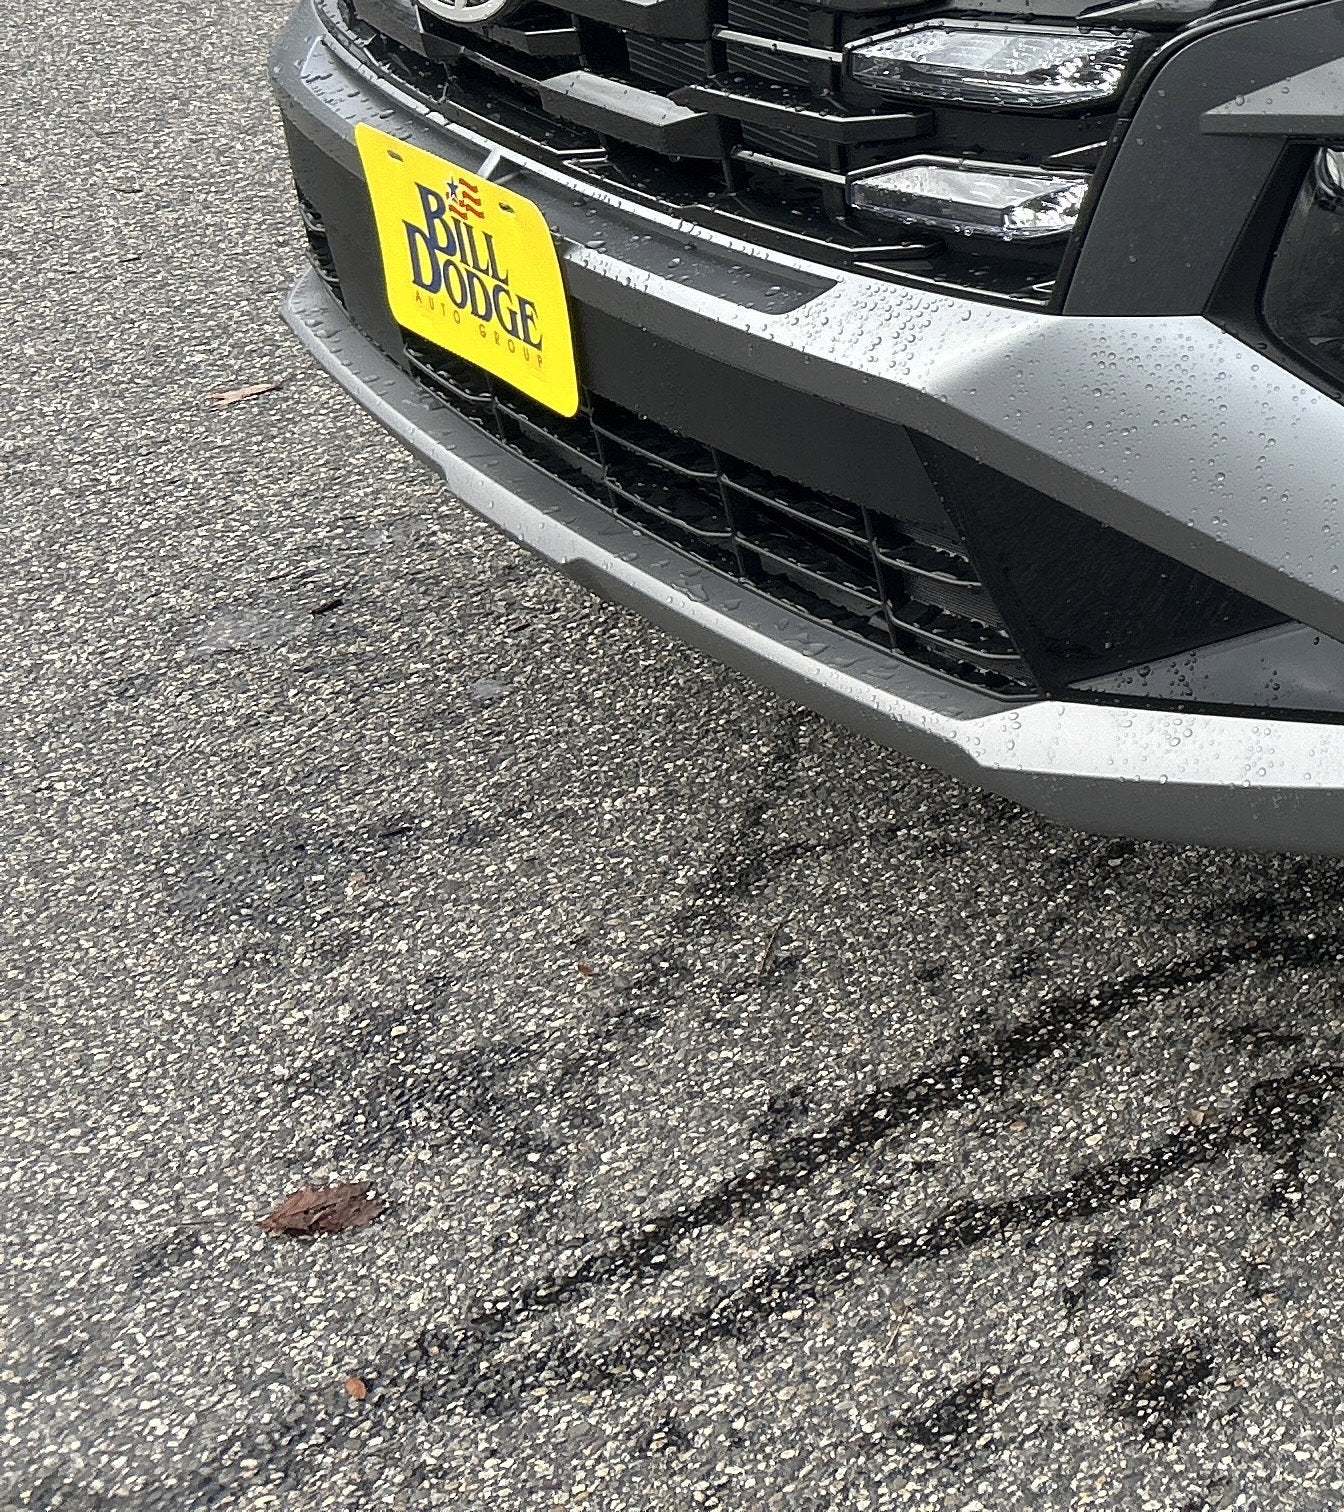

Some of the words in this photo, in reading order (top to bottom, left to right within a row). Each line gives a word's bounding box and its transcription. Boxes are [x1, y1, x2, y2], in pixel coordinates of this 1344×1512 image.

[402, 219, 543, 351] DODGE
[414, 181, 509, 286] BILL
[415, 290, 461, 325] AUTO
[479, 324, 543, 368] GROUP
